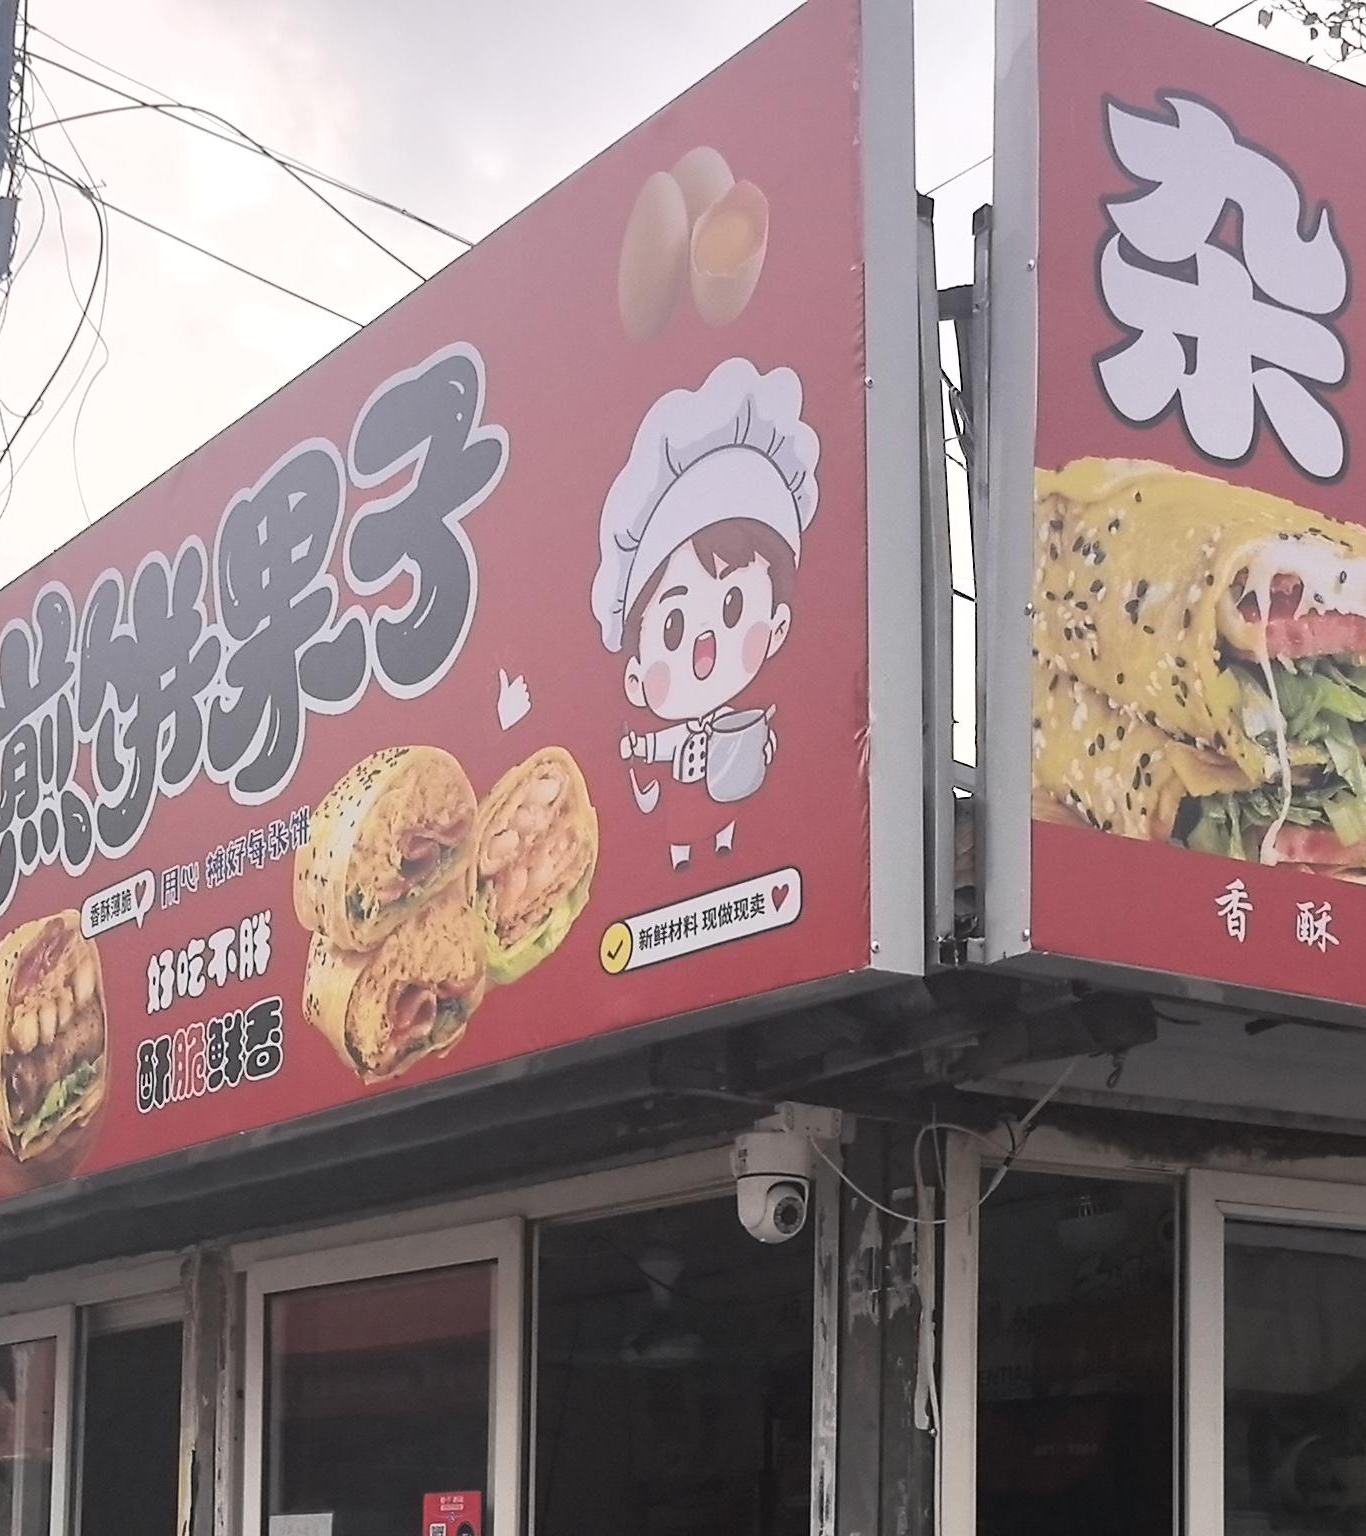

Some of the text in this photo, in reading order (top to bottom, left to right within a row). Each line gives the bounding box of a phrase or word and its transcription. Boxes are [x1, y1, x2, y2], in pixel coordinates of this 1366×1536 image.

[90, 889, 131, 928] 香酥薄脆
[161, 805, 310, 909] 用心 摊好每张饼
[147, 909, 272, 1014] 好吃不胖
[639, 893, 765, 951] 新鲜材料 现做现卖
[137, 995, 283, 1113] 酥脆鲜香
